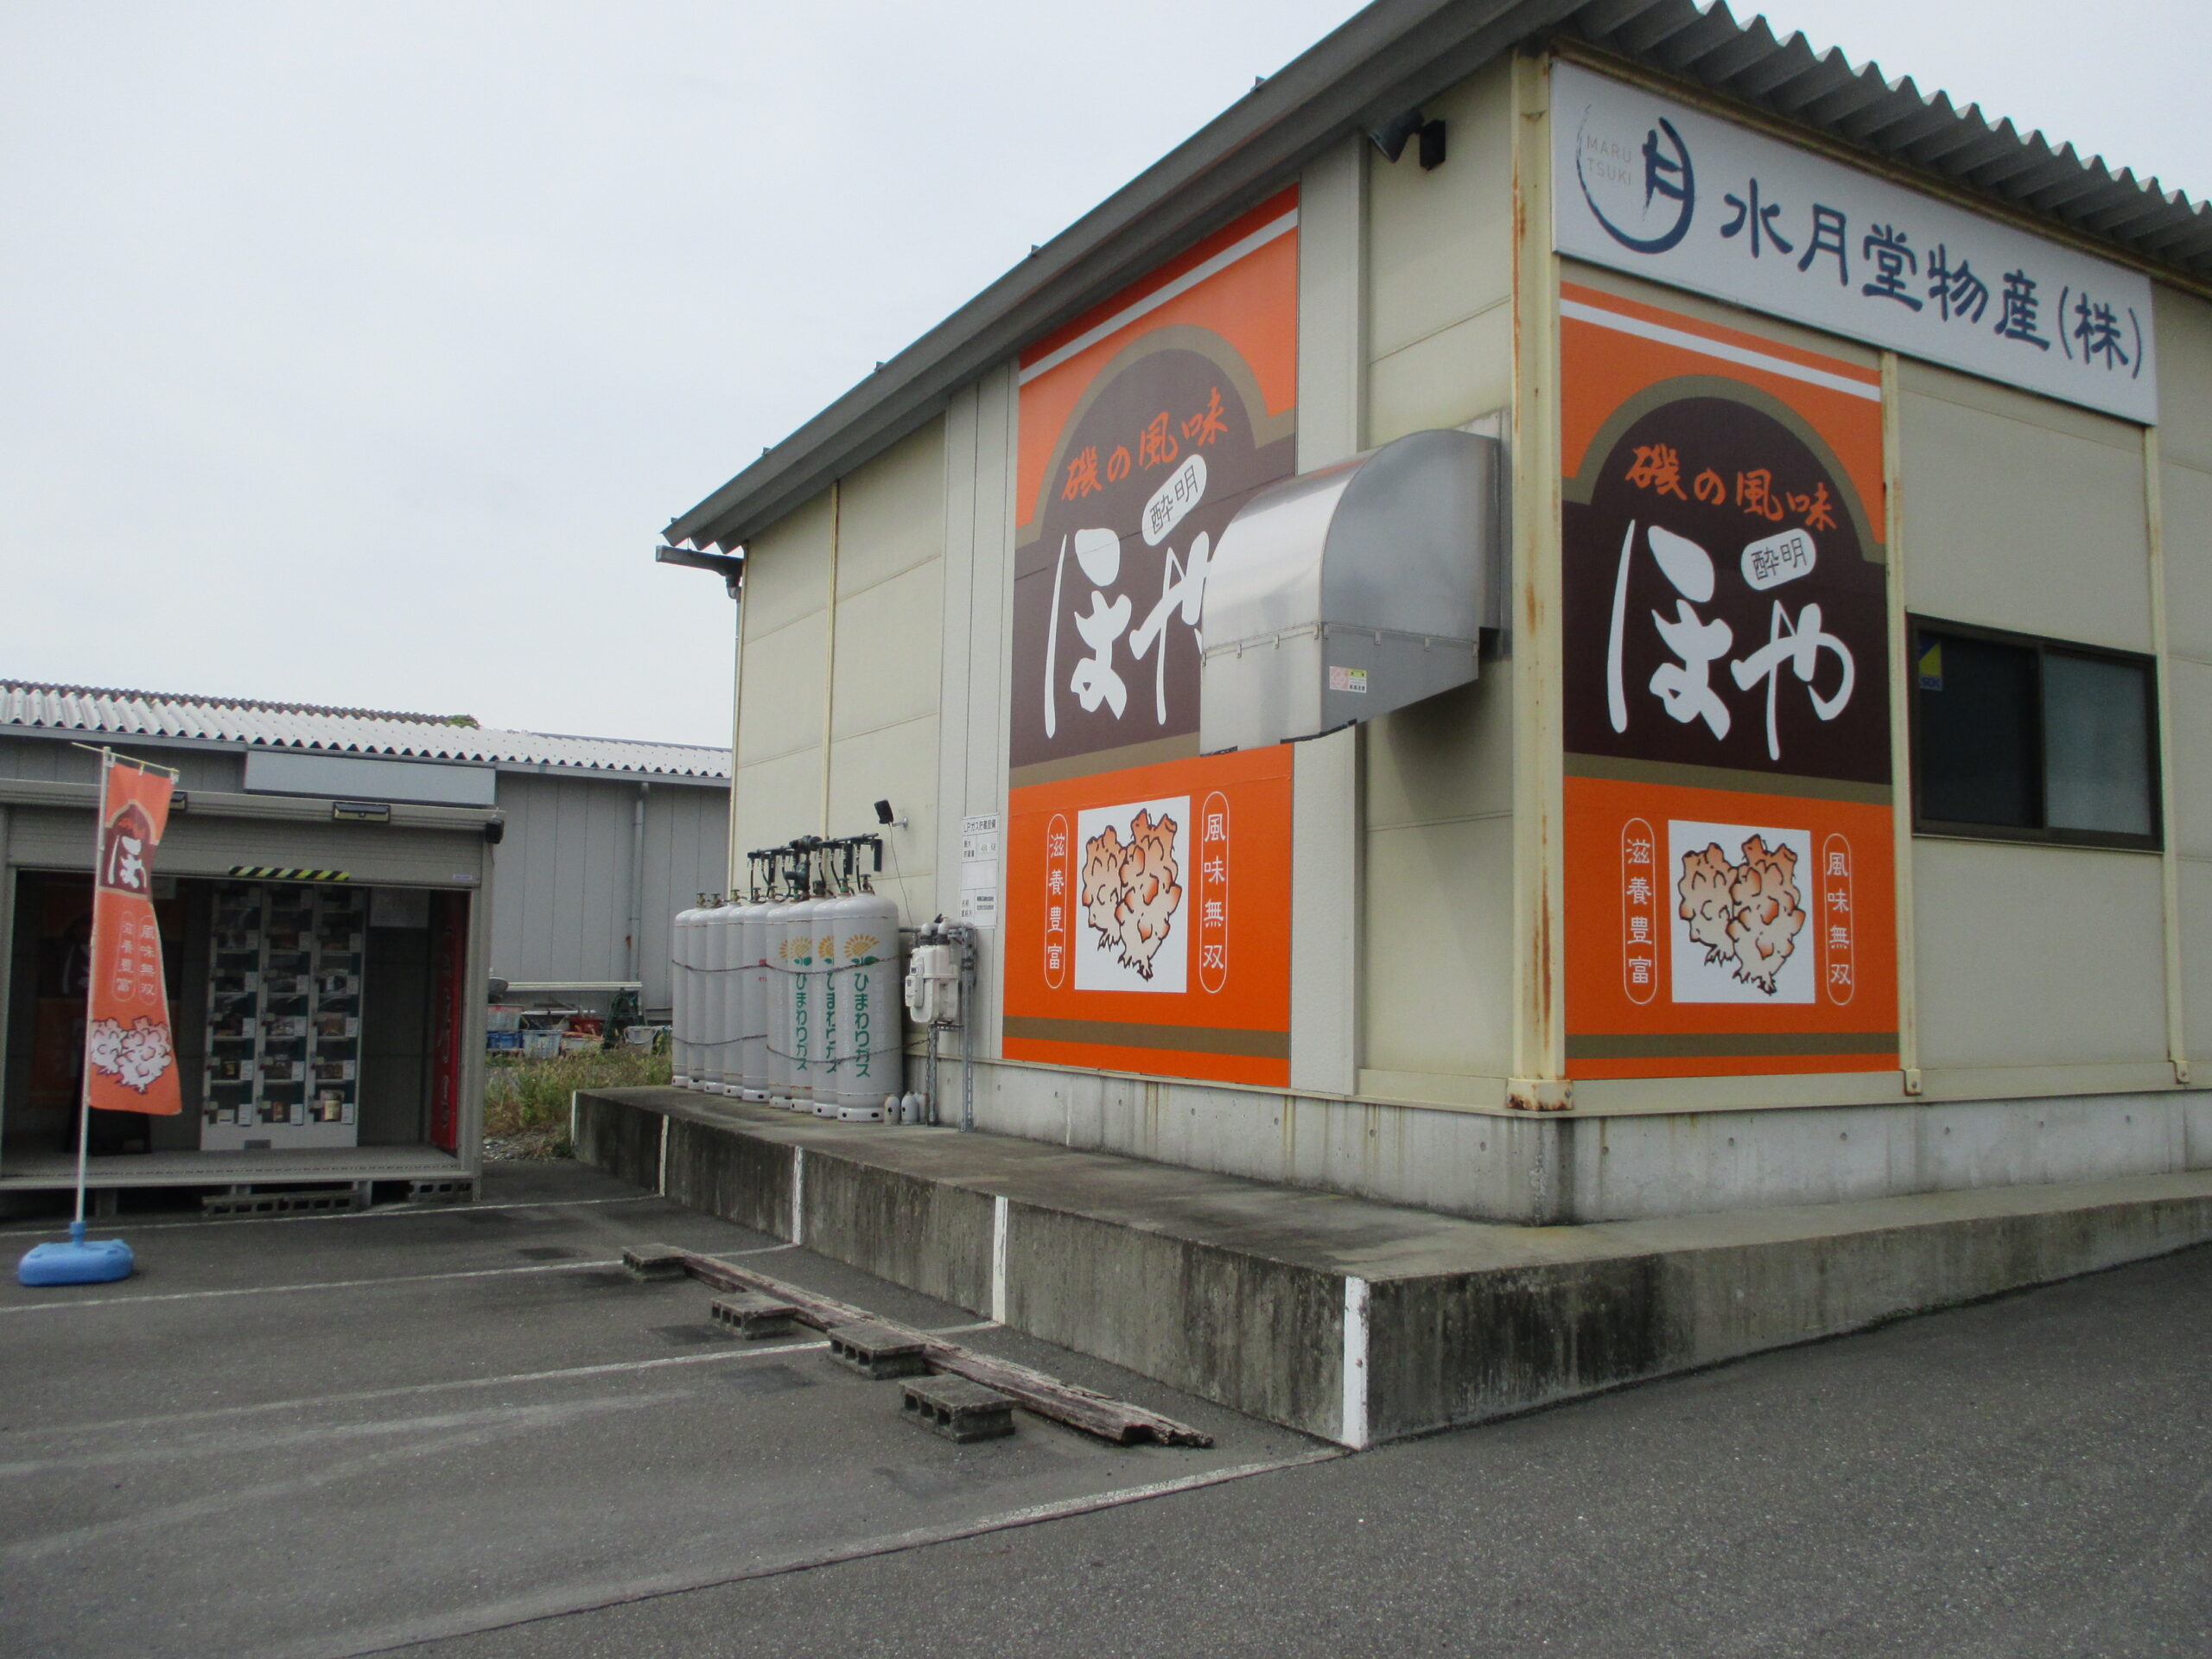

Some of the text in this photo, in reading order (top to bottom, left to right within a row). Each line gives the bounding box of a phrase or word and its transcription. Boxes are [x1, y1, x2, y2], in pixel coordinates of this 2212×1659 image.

[1586, 135, 1632, 163] MARU
[1587, 158, 1632, 187] TSUKI
[1720, 178, 2143, 379] 水月堂物産(株)
[1061, 387, 1229, 501] 磯の風味
[1625, 443, 1836, 531] 磯の風味
[1150, 464, 1199, 535] 酔明
[1751, 537, 1807, 582] 酔明
[1607, 519, 1855, 761] ほや
[1047, 833, 1065, 970] 滋養豊富
[1202, 812, 1226, 969] 風味無双
[1625, 836, 1652, 984] 滋養豊富
[1826, 850, 1852, 986] 風味無双
[796, 973, 808, 1071] ひまわりガス
[855, 973, 871, 1078] ひまわりガス
